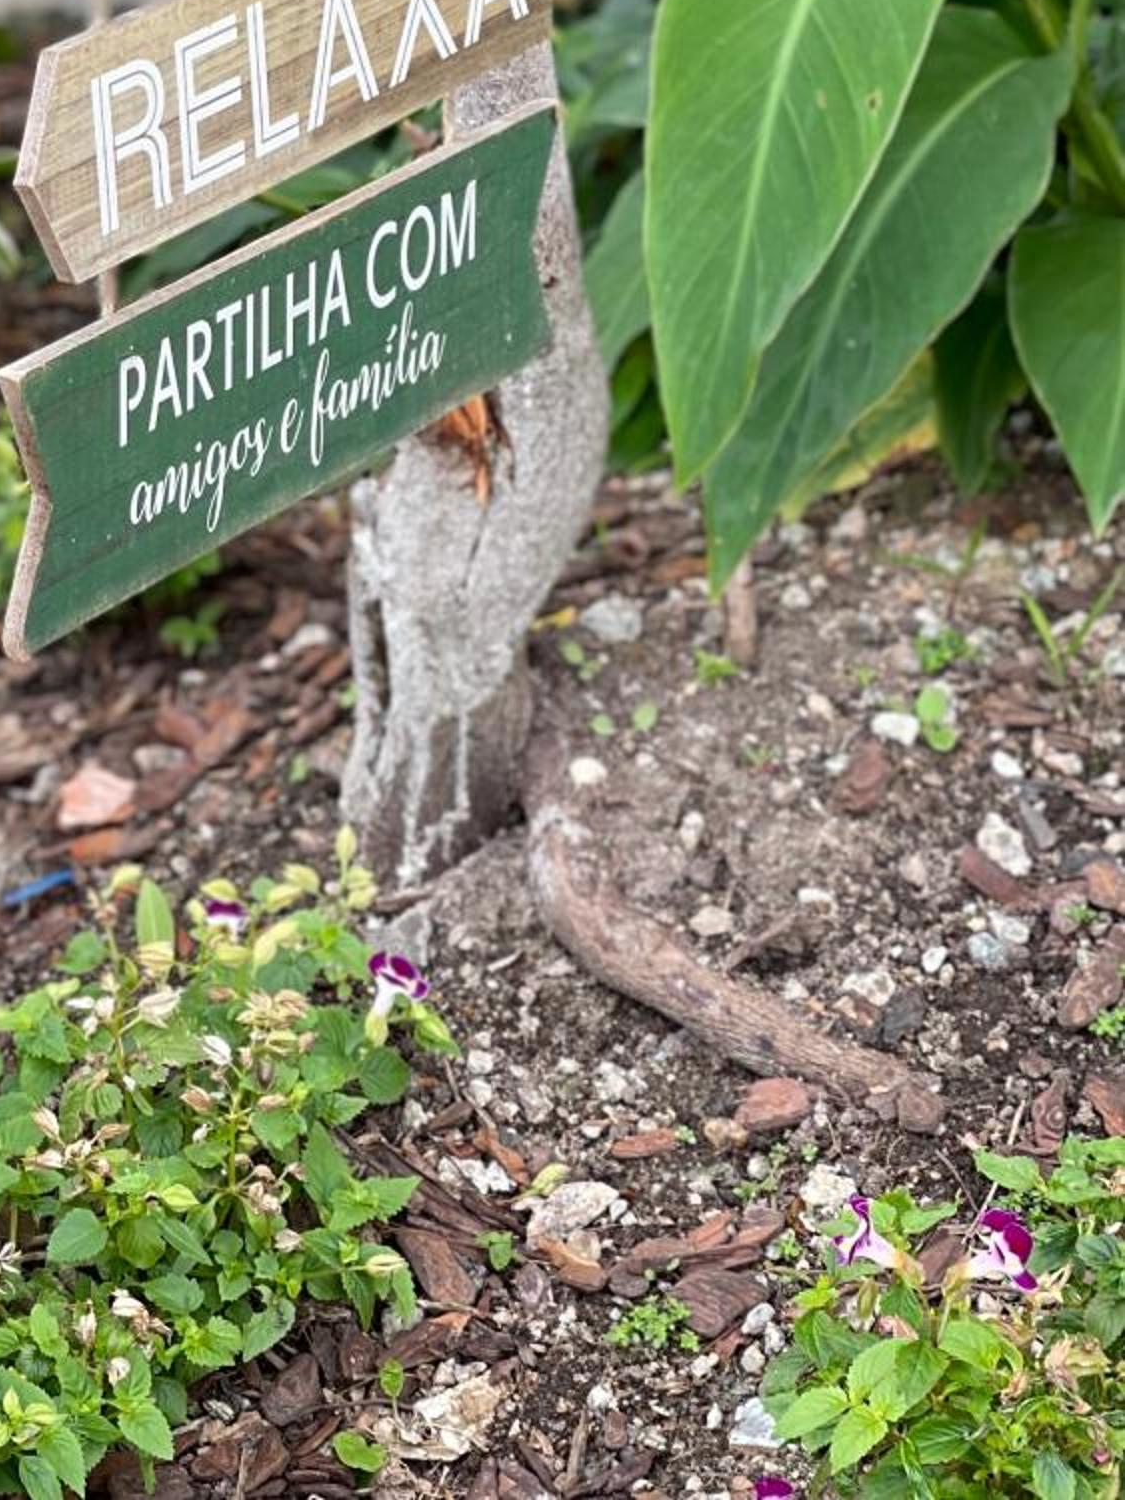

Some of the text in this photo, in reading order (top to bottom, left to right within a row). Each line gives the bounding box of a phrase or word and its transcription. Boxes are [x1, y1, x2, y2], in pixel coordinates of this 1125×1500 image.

[117, 179, 477, 446] PARTILHA COM
[130, 301, 446, 533] amigos e família
